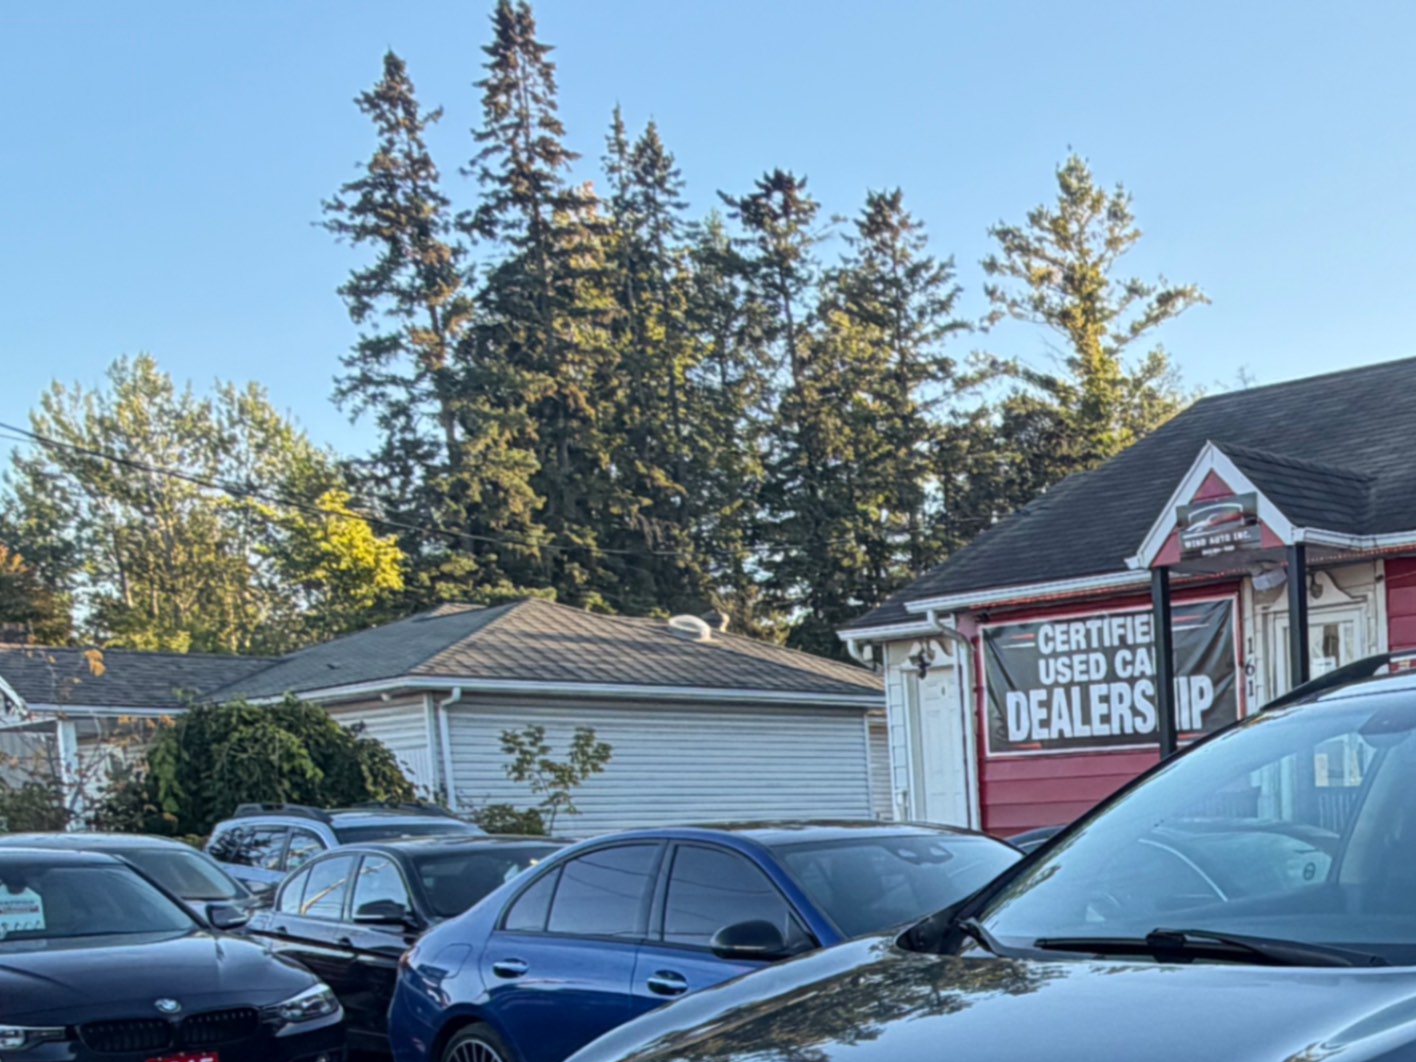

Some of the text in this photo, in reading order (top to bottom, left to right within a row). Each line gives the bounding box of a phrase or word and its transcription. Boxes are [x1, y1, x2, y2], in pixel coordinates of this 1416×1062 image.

[1209, 533, 1231, 545] AUTO
[1038, 613, 1155, 655] CERTIFIE
[1039, 646, 1157, 686] USED CA
